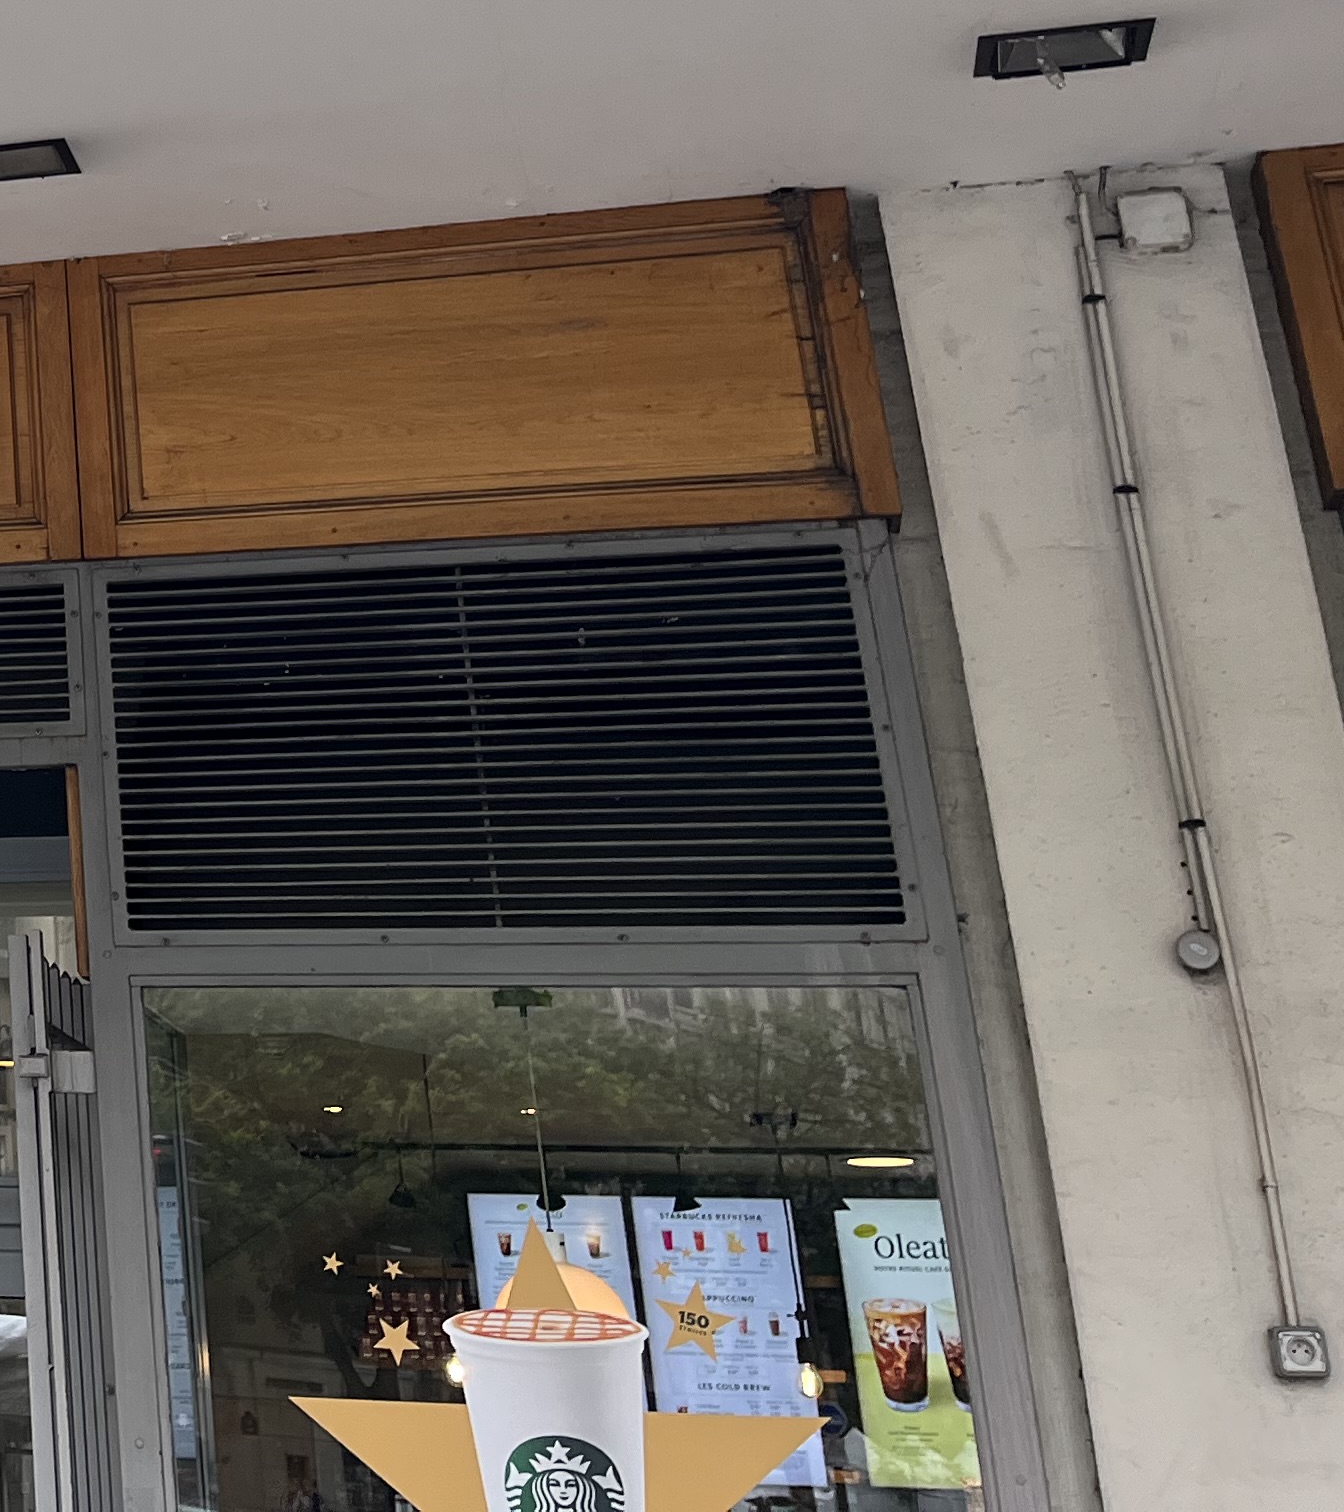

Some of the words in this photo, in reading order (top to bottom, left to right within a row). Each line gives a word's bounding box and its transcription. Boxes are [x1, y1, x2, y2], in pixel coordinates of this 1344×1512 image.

[874, 1233, 950, 1259] Oleat
[678, 1310, 710, 1328] 150
[715, 1382, 741, 1391] COLD
[743, 1383, 771, 1391] BREW
